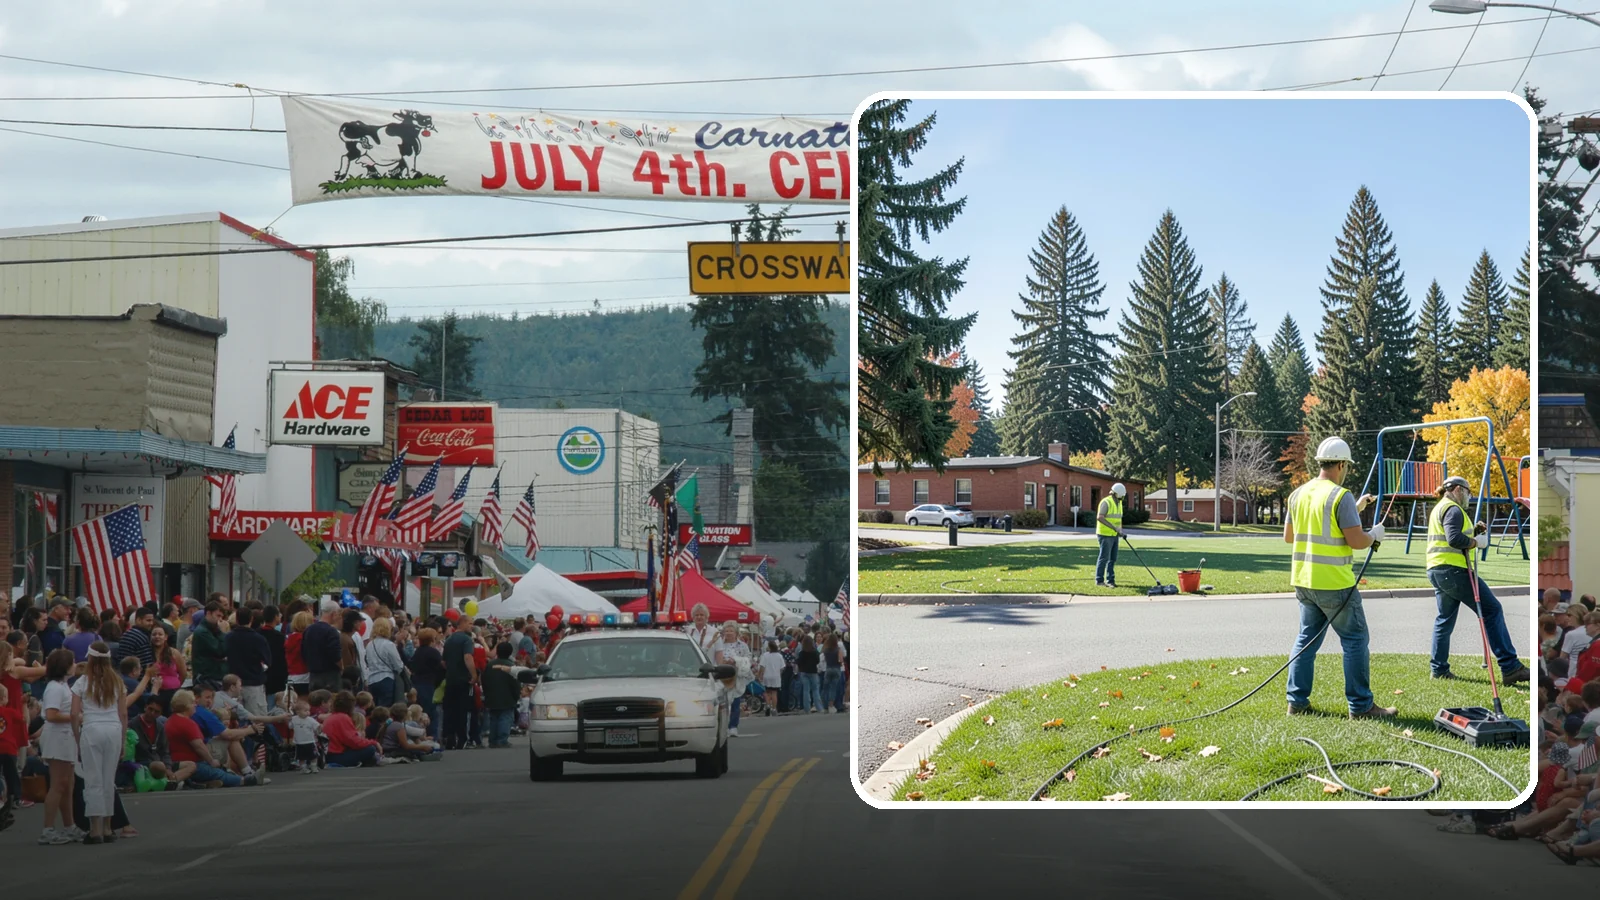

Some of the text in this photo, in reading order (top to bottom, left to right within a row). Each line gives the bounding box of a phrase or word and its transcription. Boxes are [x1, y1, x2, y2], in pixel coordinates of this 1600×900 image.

[481, 141, 604, 192] JULY
[632, 150, 746, 197] 4th.
[697, 255, 850, 280] CROSSWA
[283, 380, 373, 420] ACE
[406, 409, 452, 421] CEDAR
[283, 421, 370, 436] Hardware
[416, 428, 476, 447] Coca-Cola
[354, 467, 384, 481] Simpl
[95, 485, 124, 495] Vincent
[126, 486, 135, 495] de
[138, 486, 155, 495] Paul
[81, 503, 153, 522] THRT
[688, 527, 741, 535] CRNATION
[700, 535, 730, 543] GLASS
